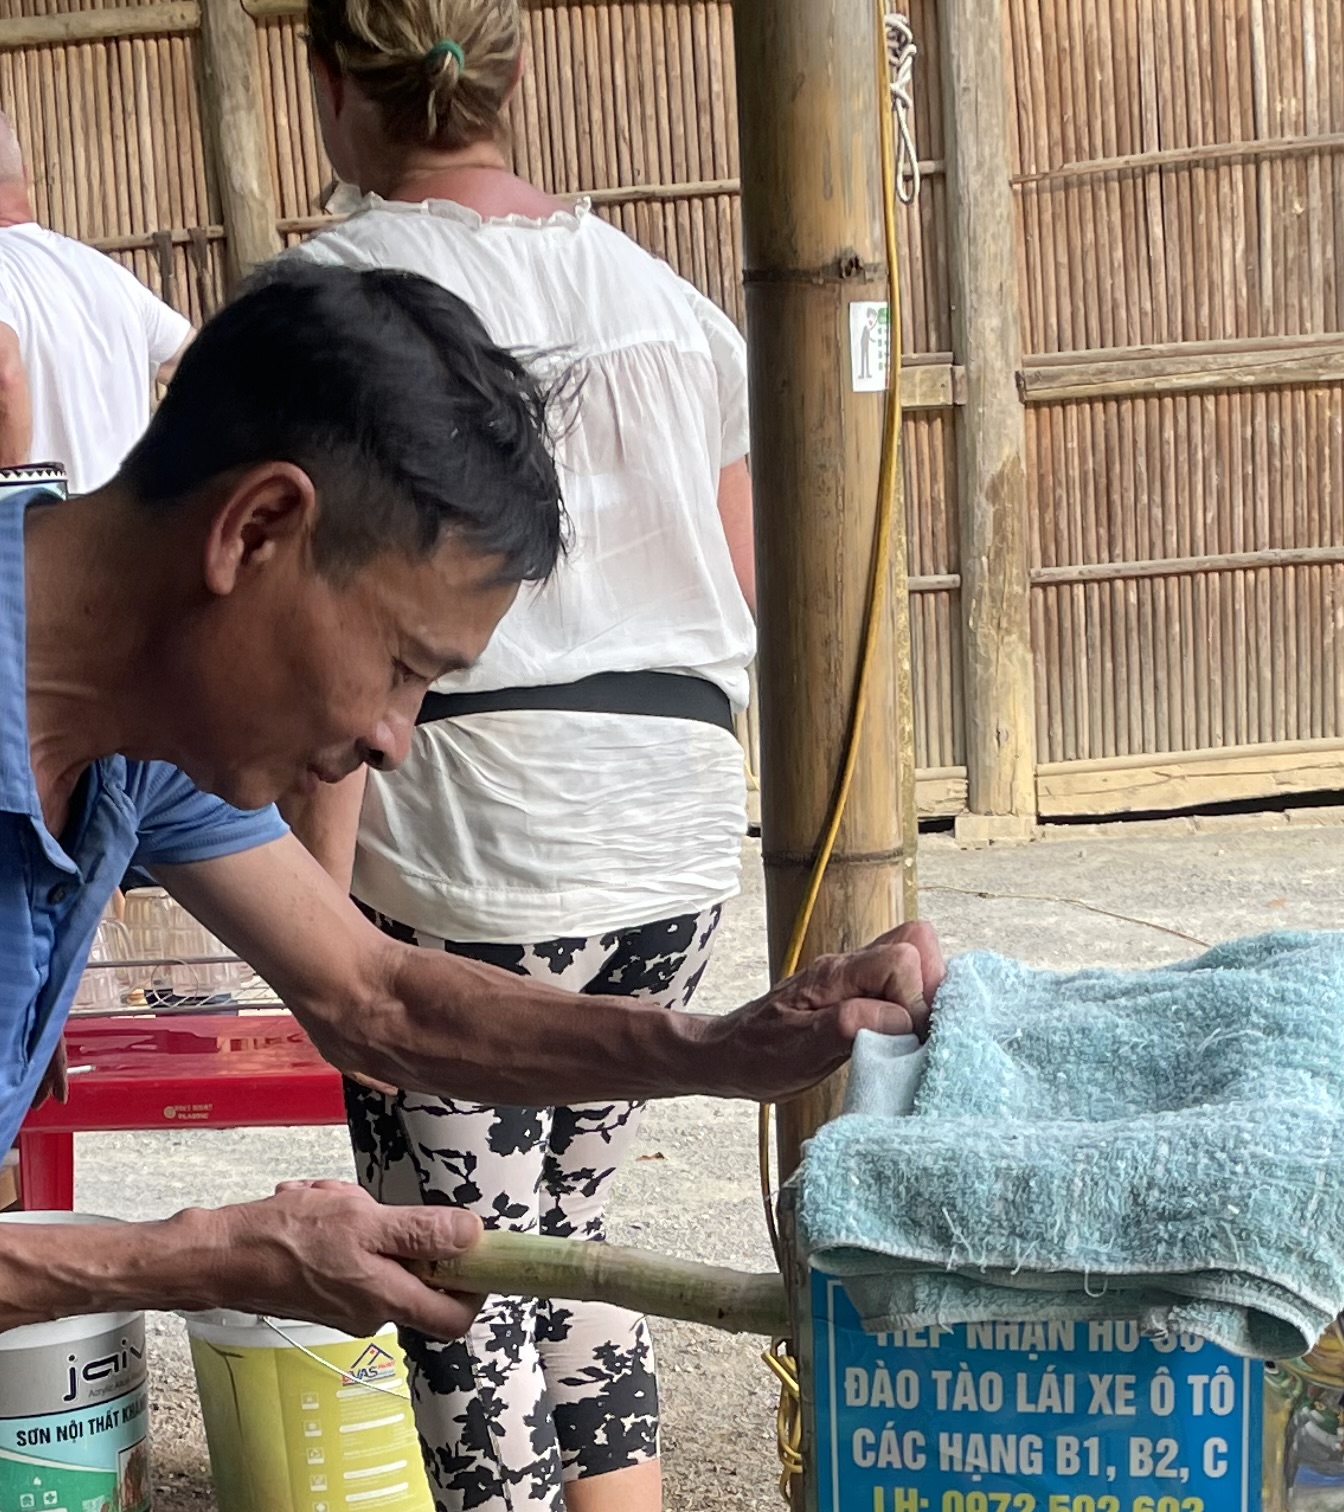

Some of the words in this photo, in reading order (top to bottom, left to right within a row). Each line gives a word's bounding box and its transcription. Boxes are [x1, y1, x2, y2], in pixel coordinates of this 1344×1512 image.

[844, 1359, 920, 1410] ĐÀO
[1016, 1365, 1075, 1414] LÁI
[1088, 1374, 1137, 1415] XE
[1150, 1366, 1175, 1416] Ô
[1187, 1365, 1235, 1416] TÔ
[16, 1427, 51, 1446] SƠN
[56, 1420, 83, 1443] NỘI
[88, 1406, 120, 1435] THẤT
[852, 1421, 927, 1470] CÁC
[939, 1432, 1043, 1482] HẠNG
[1056, 1435, 1116, 1482] B1,
[1129, 1436, 1190, 1483] B2,
[1203, 1437, 1228, 1478] C
